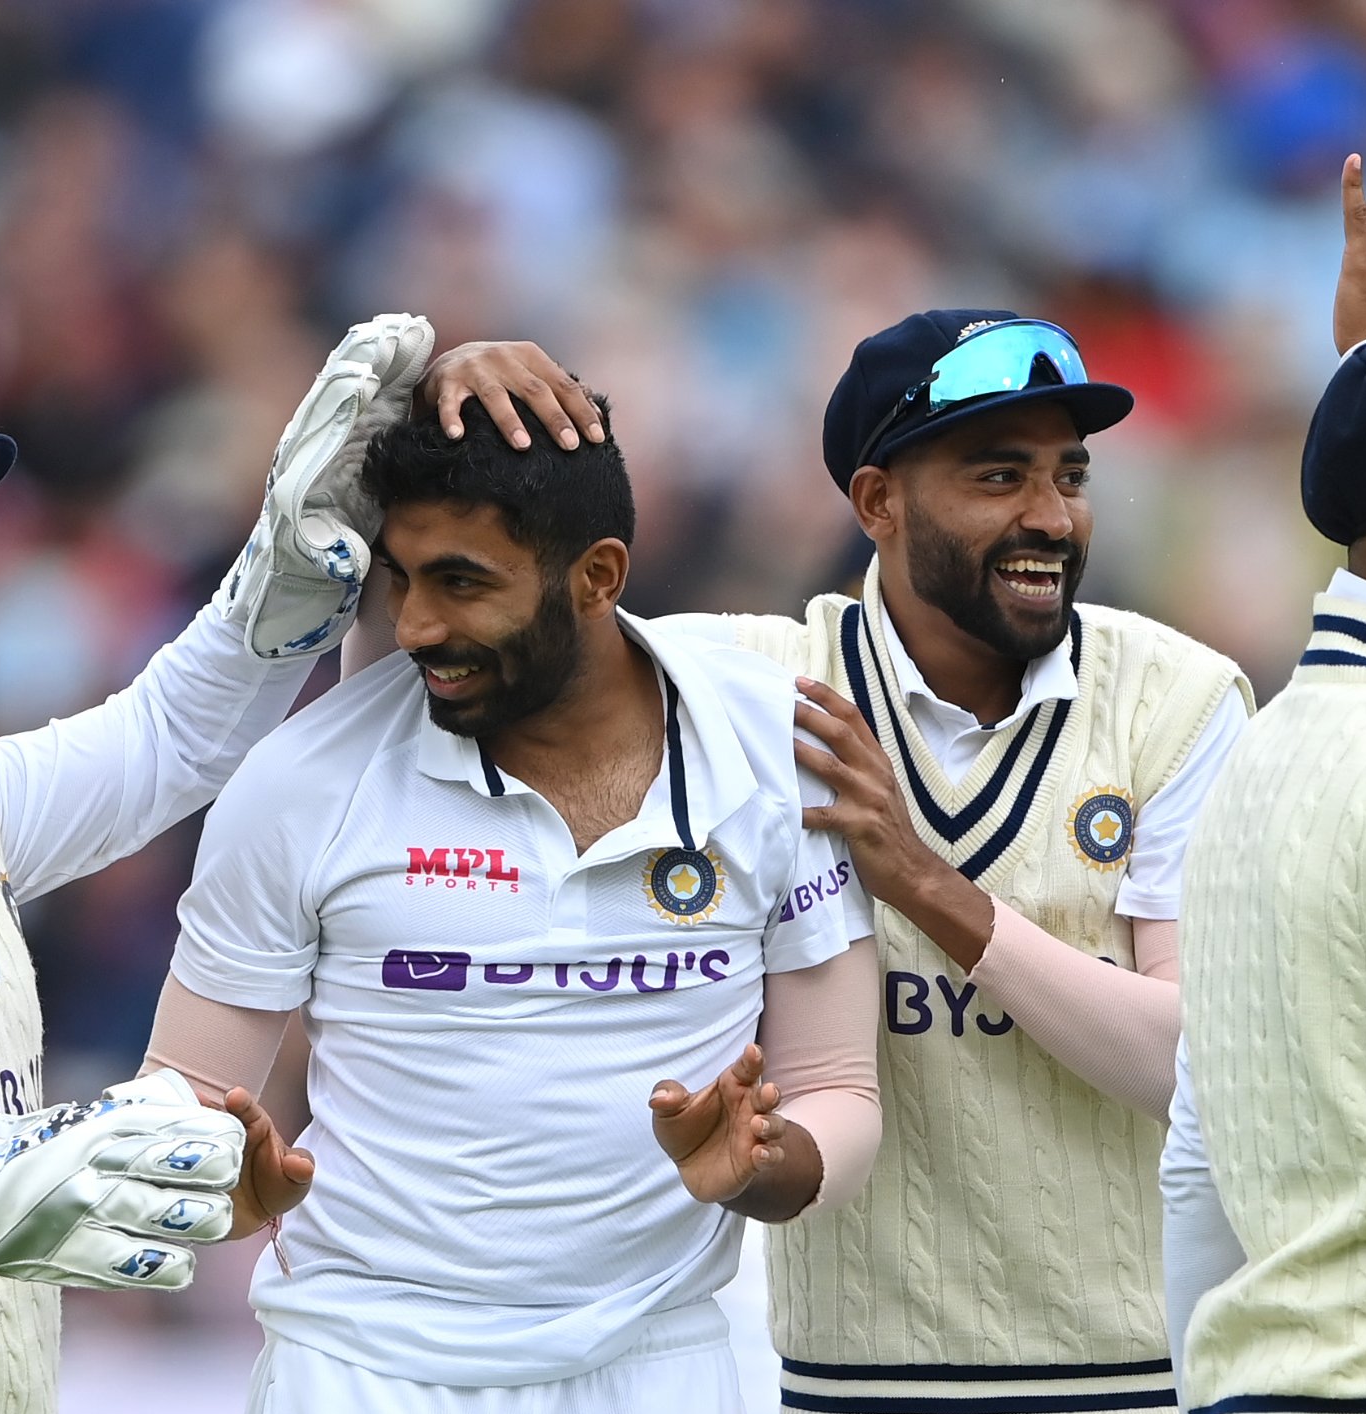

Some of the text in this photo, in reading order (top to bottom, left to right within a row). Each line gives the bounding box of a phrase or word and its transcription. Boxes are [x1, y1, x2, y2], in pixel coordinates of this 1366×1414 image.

[404, 847, 519, 882] MPL
[405, 876, 519, 893] SPORTS
[886, 971, 1014, 1037] BYJ
